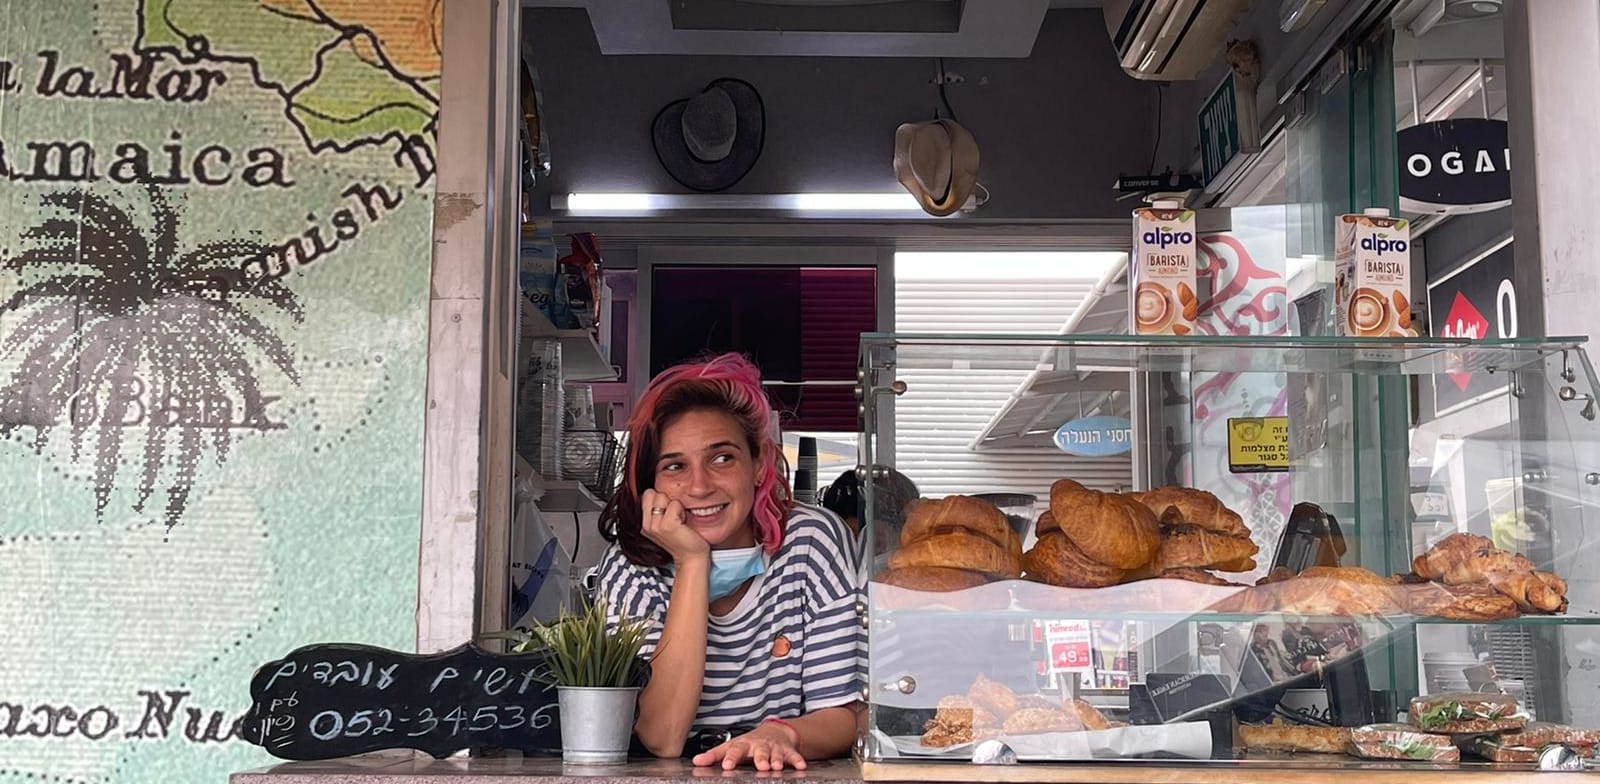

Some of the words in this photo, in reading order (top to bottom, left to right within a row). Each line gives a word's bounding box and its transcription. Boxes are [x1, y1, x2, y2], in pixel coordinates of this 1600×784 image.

[0, 130, 296, 187] maica
[1406, 147, 1511, 178] OGA
[1143, 226, 1193, 250] alpro
[1361, 233, 1408, 256] alpro
[1150, 254, 1187, 267] BARISTA
[1367, 261, 1401, 275] BARISTA
[1061, 430, 1101, 445] הנעלה
[1240, 444, 1276, 453] מצלמות
[1257, 453, 1278, 461] סגור
[1058, 650, 1078, 664] 49
